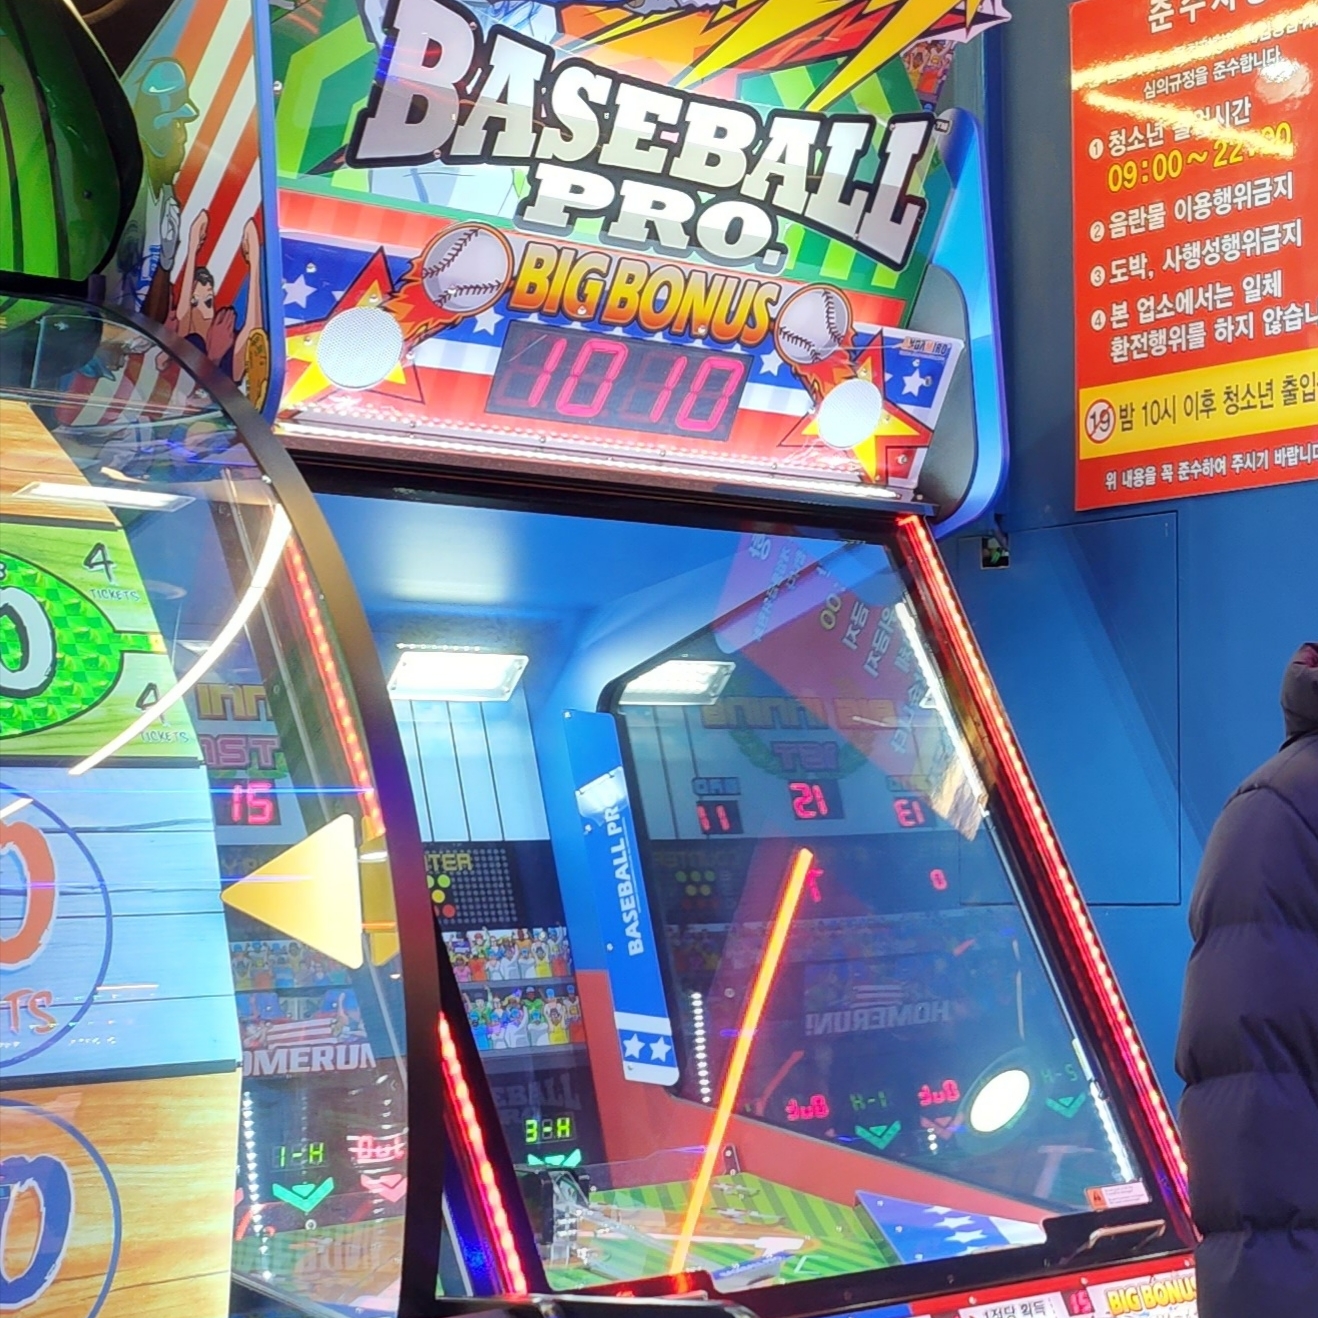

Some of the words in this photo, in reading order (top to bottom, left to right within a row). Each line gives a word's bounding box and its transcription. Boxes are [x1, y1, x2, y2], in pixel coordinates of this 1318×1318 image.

[1143, 65, 1208, 100] 심의규정을
[353, 0, 930, 268] BASEBALL
[1108, 120, 1164, 157] 청소년
[1108, 201, 1166, 239] 음란물
[1174, 171, 1294, 223] 이용행위금지
[1109, 252, 1155, 285] 도박,
[1162, 218, 1302, 273] 사행성행위금지
[507, 243, 610, 319] BIG
[602, 259, 783, 346] BONUS
[1109, 305, 1130, 329] 본
[1136, 282, 1234, 321] 업소에서는
[1242, 269, 1283, 303] 일체
[1109, 322, 1207, 363] 환전행위를
[1213, 312, 1254, 344] 하지
[1118, 402, 1135, 432] 밤
[1141, 394, 1178, 427] 10시
[1183, 388, 1218, 421] 이후
[1222, 378, 1275, 416] 청소년
[1105, 472, 1117, 491] 위
[1121, 466, 1157, 488] 내용을
[1161, 463, 1174, 483] 꼭
[1177, 453, 1227, 481] 준수하여
[1230, 448, 1269, 473] 주시기
[83, 542, 115, 583] 4
[90, 588, 141, 602] TICKETS
[1107, 1287, 1142, 1317] BIG
